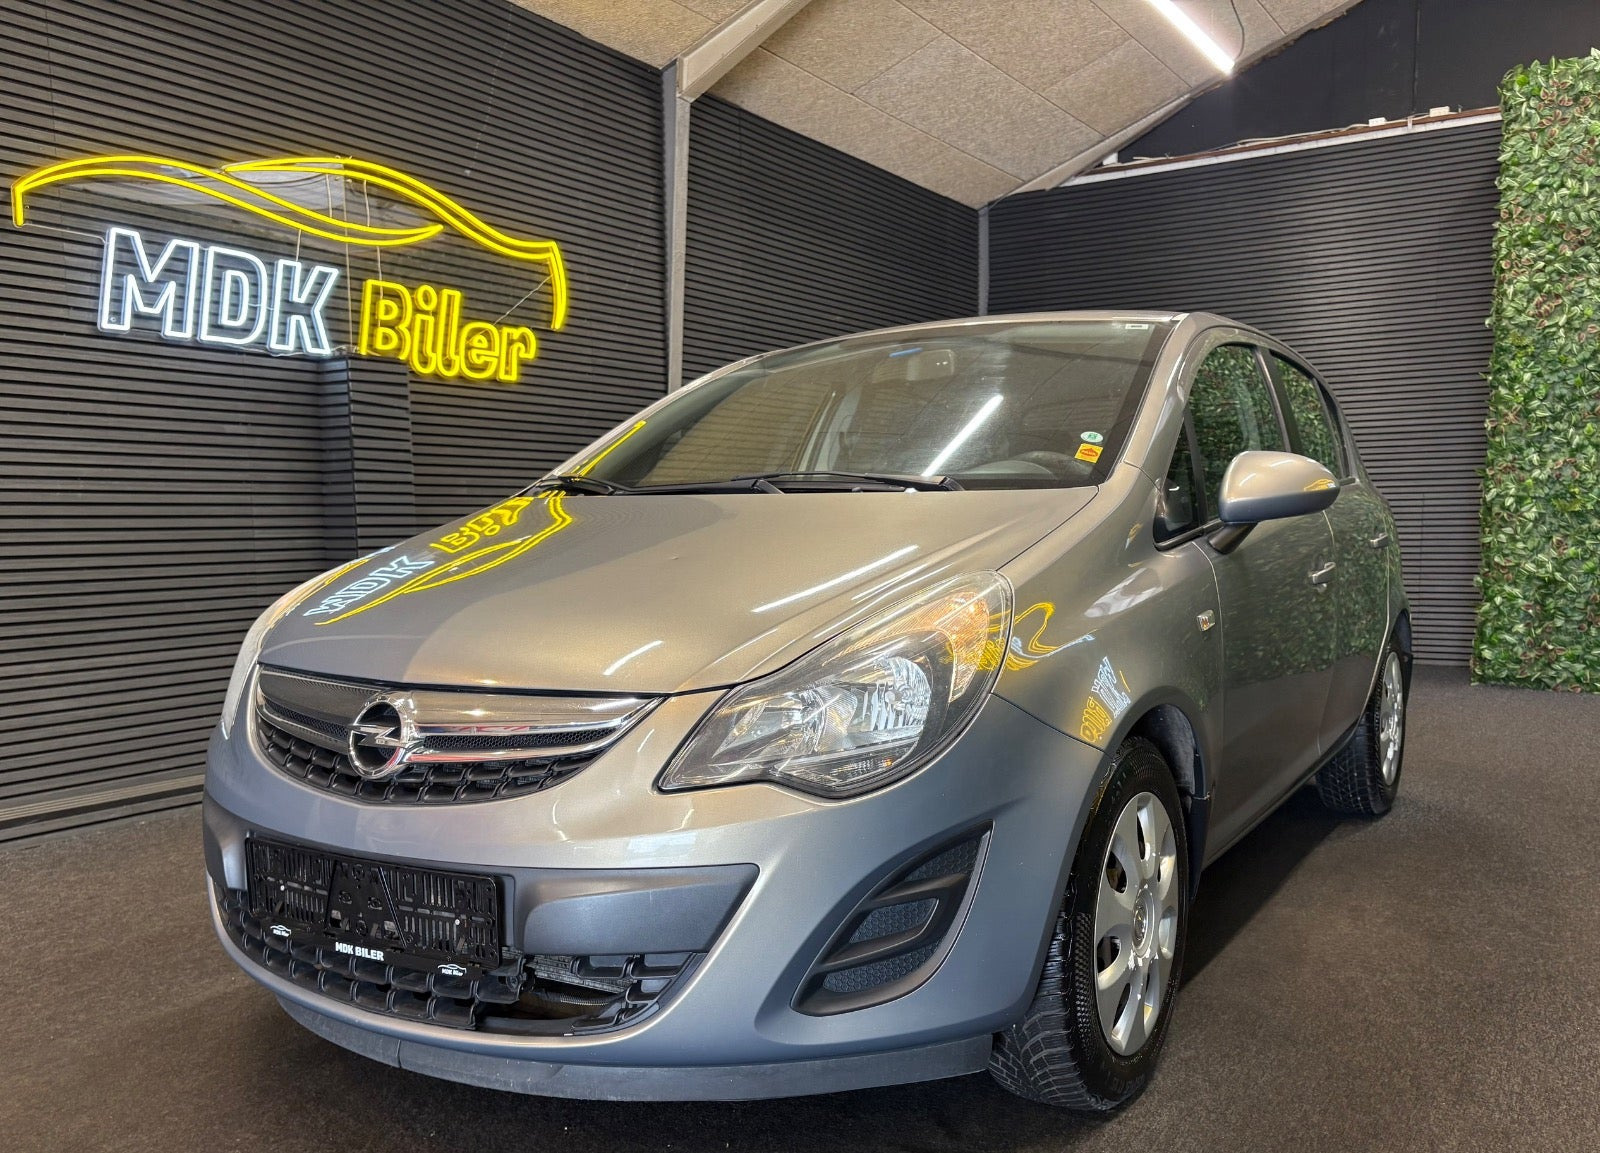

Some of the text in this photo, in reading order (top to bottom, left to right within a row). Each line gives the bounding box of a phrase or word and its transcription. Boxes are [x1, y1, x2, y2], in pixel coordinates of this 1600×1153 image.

[99, 226, 537, 382] MDK Biler
[335, 942, 384, 961] MDK BILER
